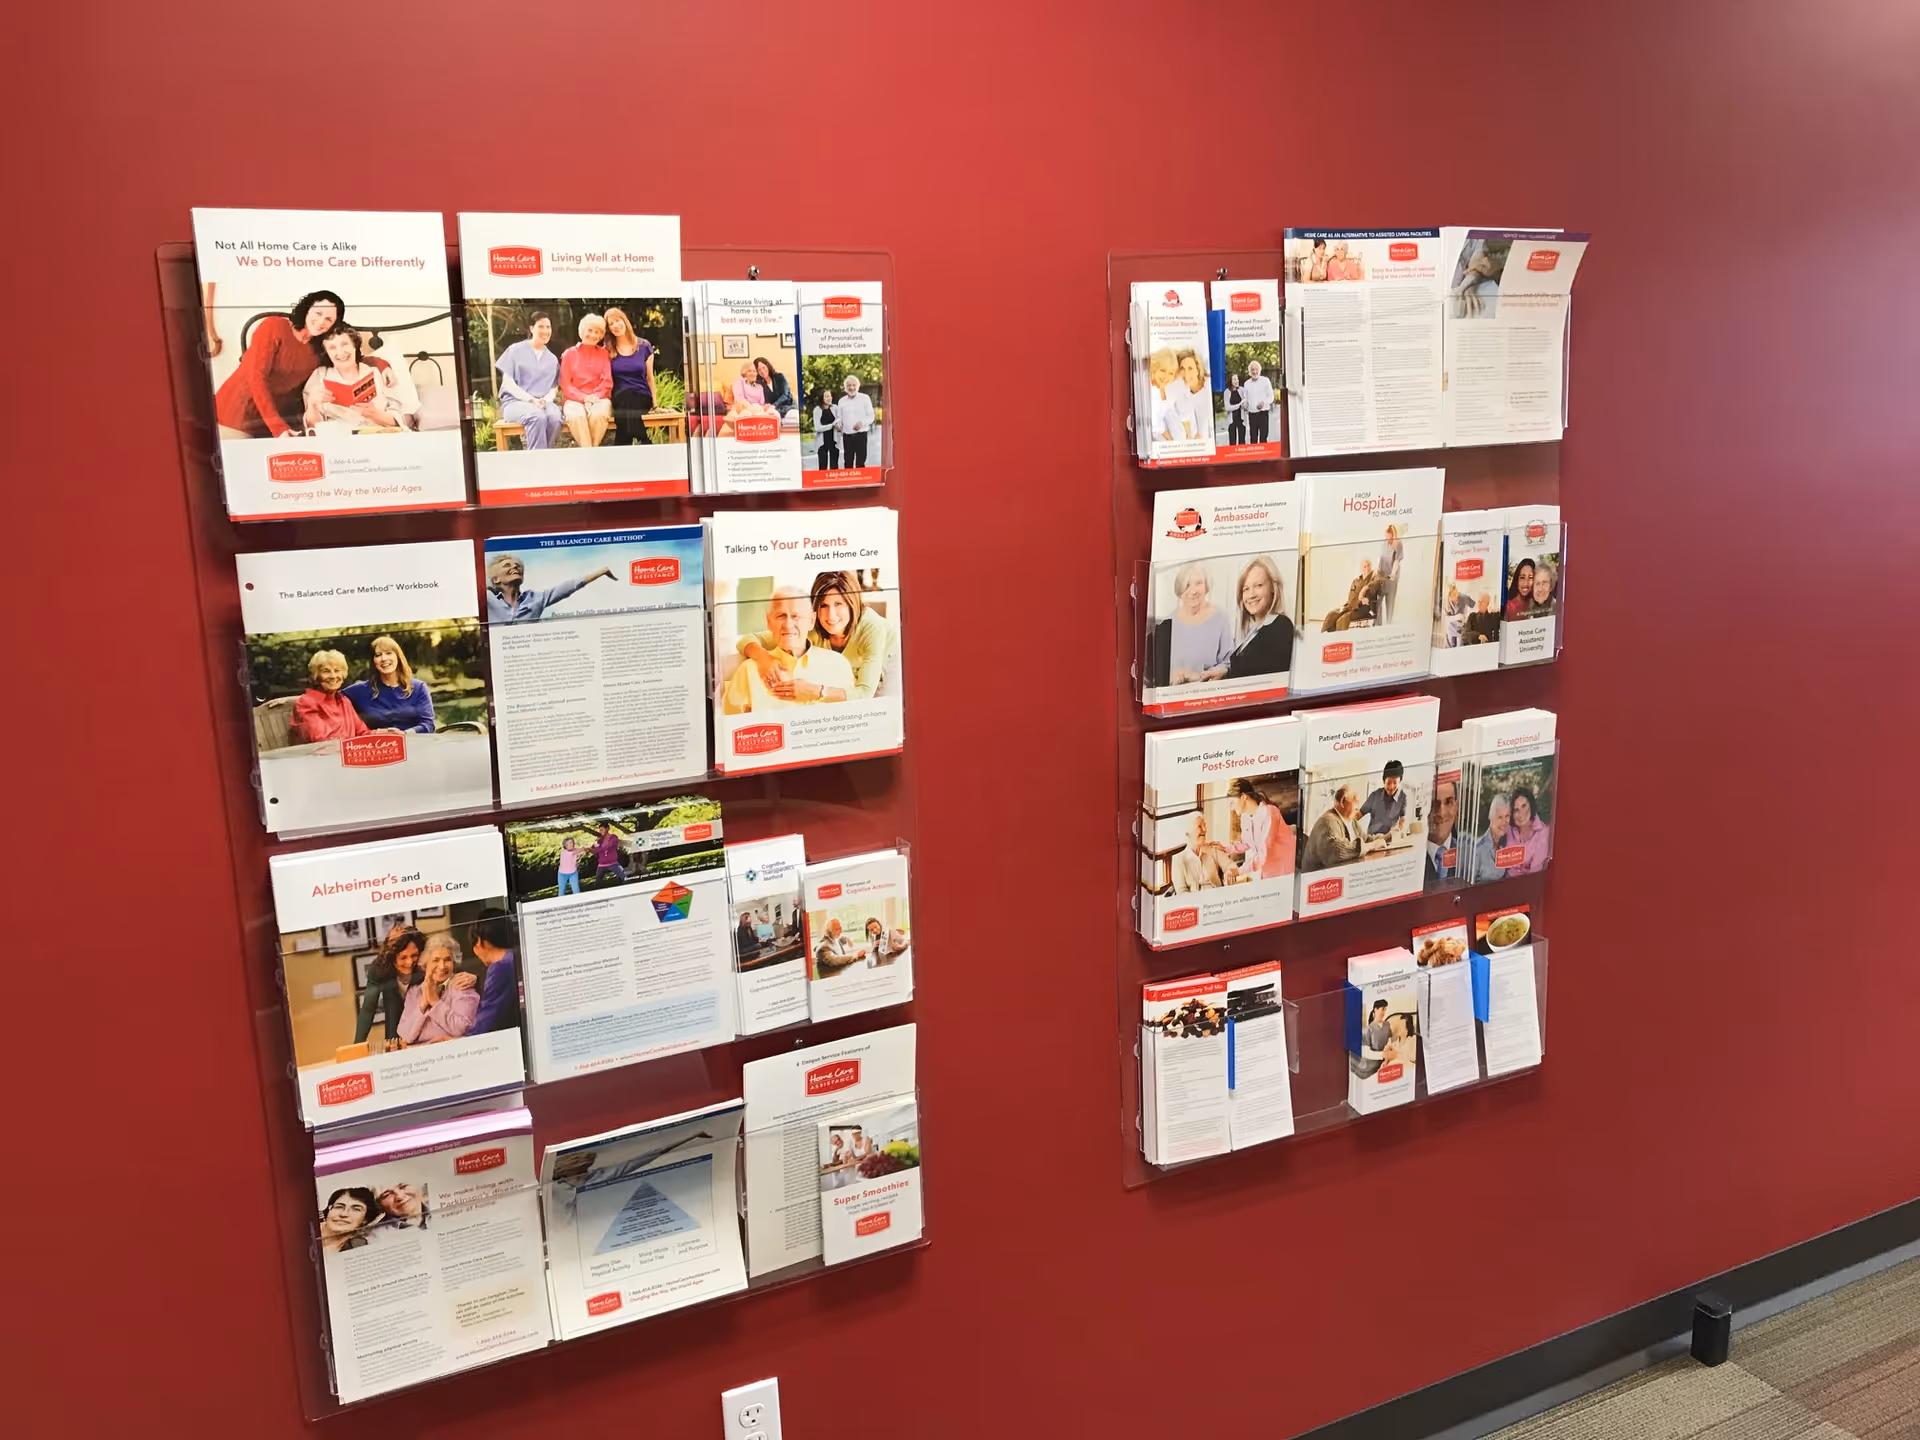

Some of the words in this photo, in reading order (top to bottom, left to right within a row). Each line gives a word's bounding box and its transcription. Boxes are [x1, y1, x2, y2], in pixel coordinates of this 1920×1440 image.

[215, 240, 236, 251] Not
[240, 240, 254, 251] All
[257, 241, 288, 252] Home
[292, 242, 317, 252] Care
[320, 242, 329, 252] is
[331, 242, 358, 252] Alike
[236, 256, 259, 268] We
[263, 256, 282, 268] Do
[286, 256, 324, 269] Home
[328, 256, 358, 269] Care
[361, 256, 426, 270] Differently
[493, 253, 515, 263] Home
[514, 252, 537, 263] Care
[552, 252, 582, 266] Living
[584, 252, 608, 263] Well
[611, 253, 622, 263] at
[625, 253, 655, 264] Home
[494, 263, 537, 271] ASSISTANCE
[731, 306, 755, 315] home
[756, 306, 761, 315] is
[761, 306, 772, 315] the
[720, 316, 736, 325] best
[737, 317, 753, 326] way
[754, 316, 763, 325] to
[821, 327, 849, 335] Preferred
[849, 326, 874, 335] Provider
[820, 335, 827, 343] of
[818, 343, 853, 353] Dependable
[853, 342, 867, 351] Care
[737, 423, 757, 433] Home
[757, 422, 774, 432] Care
[272, 456, 298, 467] Home
[298, 456, 318, 466] Care
[271, 490, 314, 501] Changing
[317, 488, 331, 498] the
[332, 488, 353, 499] Way
[356, 487, 370, 496] the
[372, 485, 398, 496] World
[401, 484, 423, 496] Ages
[1354, 491, 1371, 499] FROM
[1213, 506, 1233, 514] Become
[1264, 501, 1287, 509] Assistance
[1343, 492, 1397, 516] Hospital
[1213, 508, 1269, 524] Ambassador
[1381, 509, 1397, 517] HOME
[1399, 507, 1413, 515] CARE
[539, 540, 555, 548] THE
[556, 537, 593, 547] BALANCED
[594, 536, 612, 545] CARE
[724, 545, 756, 555] Talking
[758, 544, 768, 554] to
[770, 540, 800, 551] Your
[803, 536, 848, 549] Parents
[804, 552, 830, 561] About
[832, 550, 857, 560] Home
[859, 548, 879, 558] Care
[633, 564, 656, 574] Home
[656, 564, 674, 573] Care
[1457, 565, 1470, 573] Home
[634, 572, 675, 581] ASSISTANCE
[279, 591, 294, 600] The
[297, 588, 334, 599] Balanced
[336, 586, 356, 597] Care
[396, 580, 439, 593] Workbook
[1518, 628, 1533, 636] Home
[1534, 626, 1546, 634] Care
[1519, 635, 1545, 644] Assistance
[1519, 644, 1544, 654] University
[790, 718, 822, 729] Guidelines
[823, 717, 832, 725] for
[832, 713, 863, 724] facilitating
[737, 731, 759, 741] Home
[759, 728, 778, 738] Care
[790, 729, 804, 737] care
[805, 727, 813, 735] for
[814, 727, 828, 738] your
[829, 724, 846, 735] aging
[846, 721, 869, 732] parents
[1318, 733, 1341, 743] Patient
[1342, 730, 1361, 740] Guide
[1362, 727, 1372, 736] for
[346, 740, 374, 751] Home
[375, 739, 399, 750] Care
[1333, 739, 1365, 752] Cardiac
[1367, 730, 1424, 747] Rehabilitation
[1496, 732, 1541, 749] Exceptional
[347, 748, 399, 758] ASSISTANCE
[1177, 754, 1201, 764] Patient
[1203, 751, 1223, 762] Guide
[1225, 749, 1235, 758] for
[1202, 756, 1255, 773] Post-Stroke
[1257, 753, 1279, 766] Care
[761, 861, 786, 870] Cognitive
[764, 873, 784, 882] Method
[311, 872, 399, 898] Alzheimer's
[400, 871, 420, 883] and
[1310, 884, 1326, 893] Home
[1326, 881, 1339, 891] Care
[371, 882, 443, 903] Dementia
[446, 880, 470, 892] Care
[1203, 901, 1223, 913] Planning
[1260, 891, 1281, 901] recovery
[1166, 913, 1181, 922] Home
[1181, 910, 1195, 920] Care
[1214, 983, 1224, 991] Mix
[1394, 982, 1406, 991] Care
[821, 1051, 841, 1061] Service
[841, 1047, 864, 1057] Features
[809, 1072, 833, 1084] Home
[834, 1067, 855, 1079] Care
[322, 1082, 346, 1093] Home
[346, 1077, 367, 1088] Care
[809, 1075, 856, 1091] ASSISTANCE
[458, 1157, 482, 1168] Home
[482, 1152, 500, 1163] Care
[438, 1192, 450, 1203] We
[450, 1187, 475, 1199] make
[475, 1182, 501, 1195] living
[833, 1193, 861, 1208] Super
[862, 1179, 910, 1199] Smoothies
